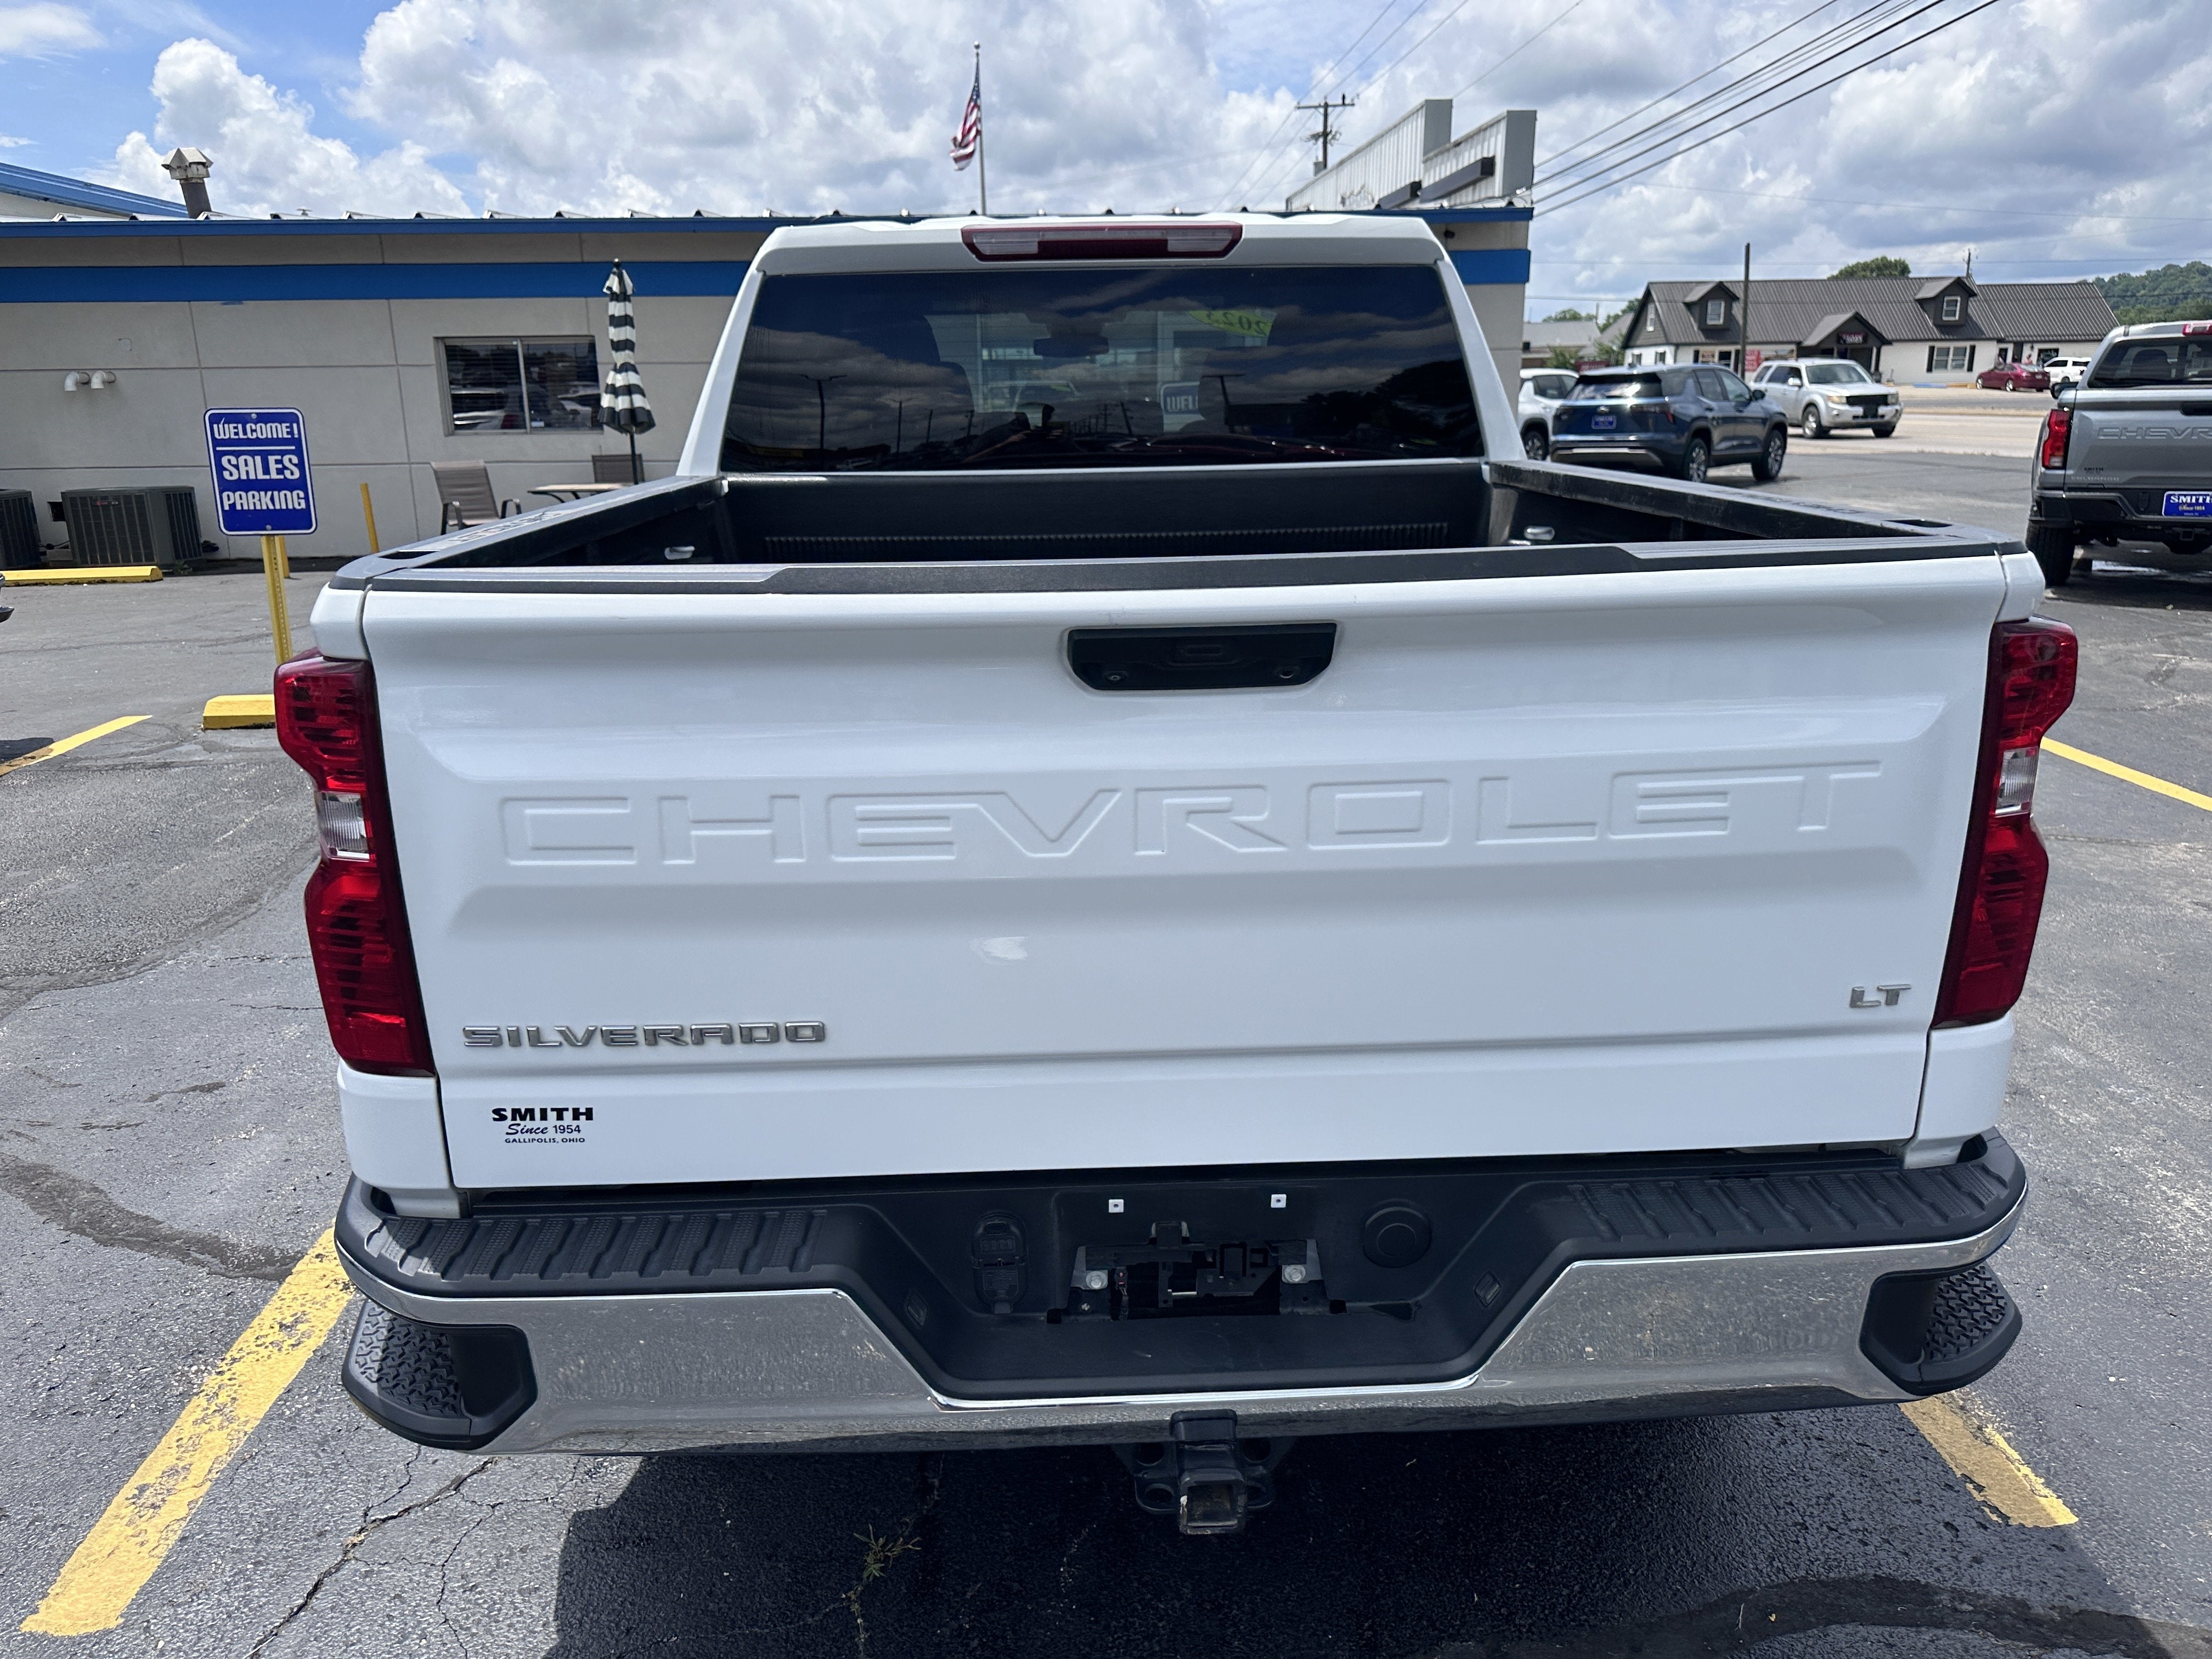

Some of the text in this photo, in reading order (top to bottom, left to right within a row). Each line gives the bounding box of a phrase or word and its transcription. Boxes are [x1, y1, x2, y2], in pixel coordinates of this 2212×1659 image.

[221, 455, 300, 480] SALES
[222, 490, 306, 510] PARKING
[499, 760, 1882, 870] CHEVROLET
[1849, 984, 1911, 1008] LT
[462, 1021, 825, 1047] SILVERADO
[492, 1107, 593, 1121] SMITH
[505, 1123, 581, 1135] Since 1954
